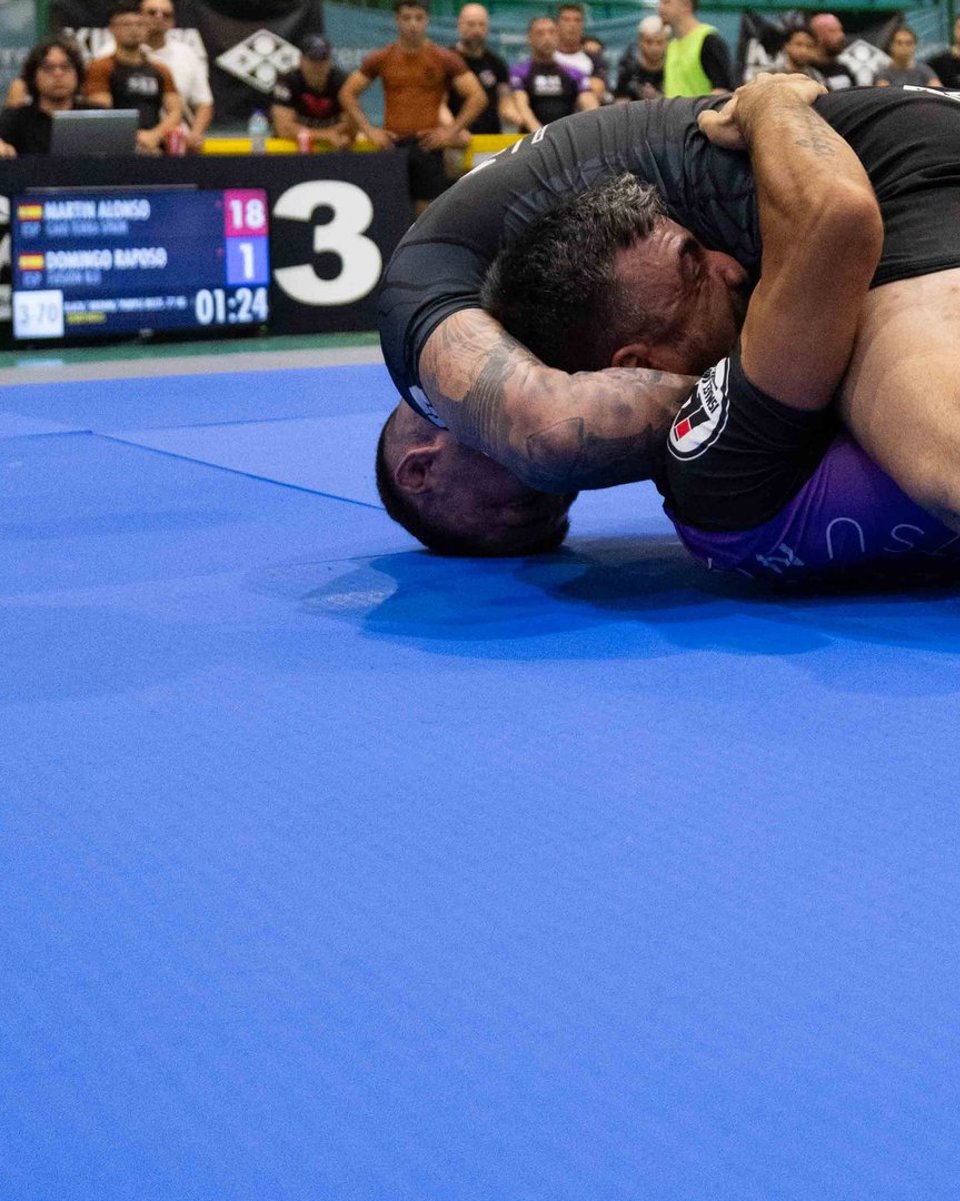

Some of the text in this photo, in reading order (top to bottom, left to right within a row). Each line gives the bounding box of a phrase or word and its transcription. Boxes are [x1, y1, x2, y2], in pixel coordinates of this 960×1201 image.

[229, 198, 266, 229] 18
[239, 242, 254, 280] 1
[273, 180, 382, 304] 3
[195, 287, 269, 325] 01:24
